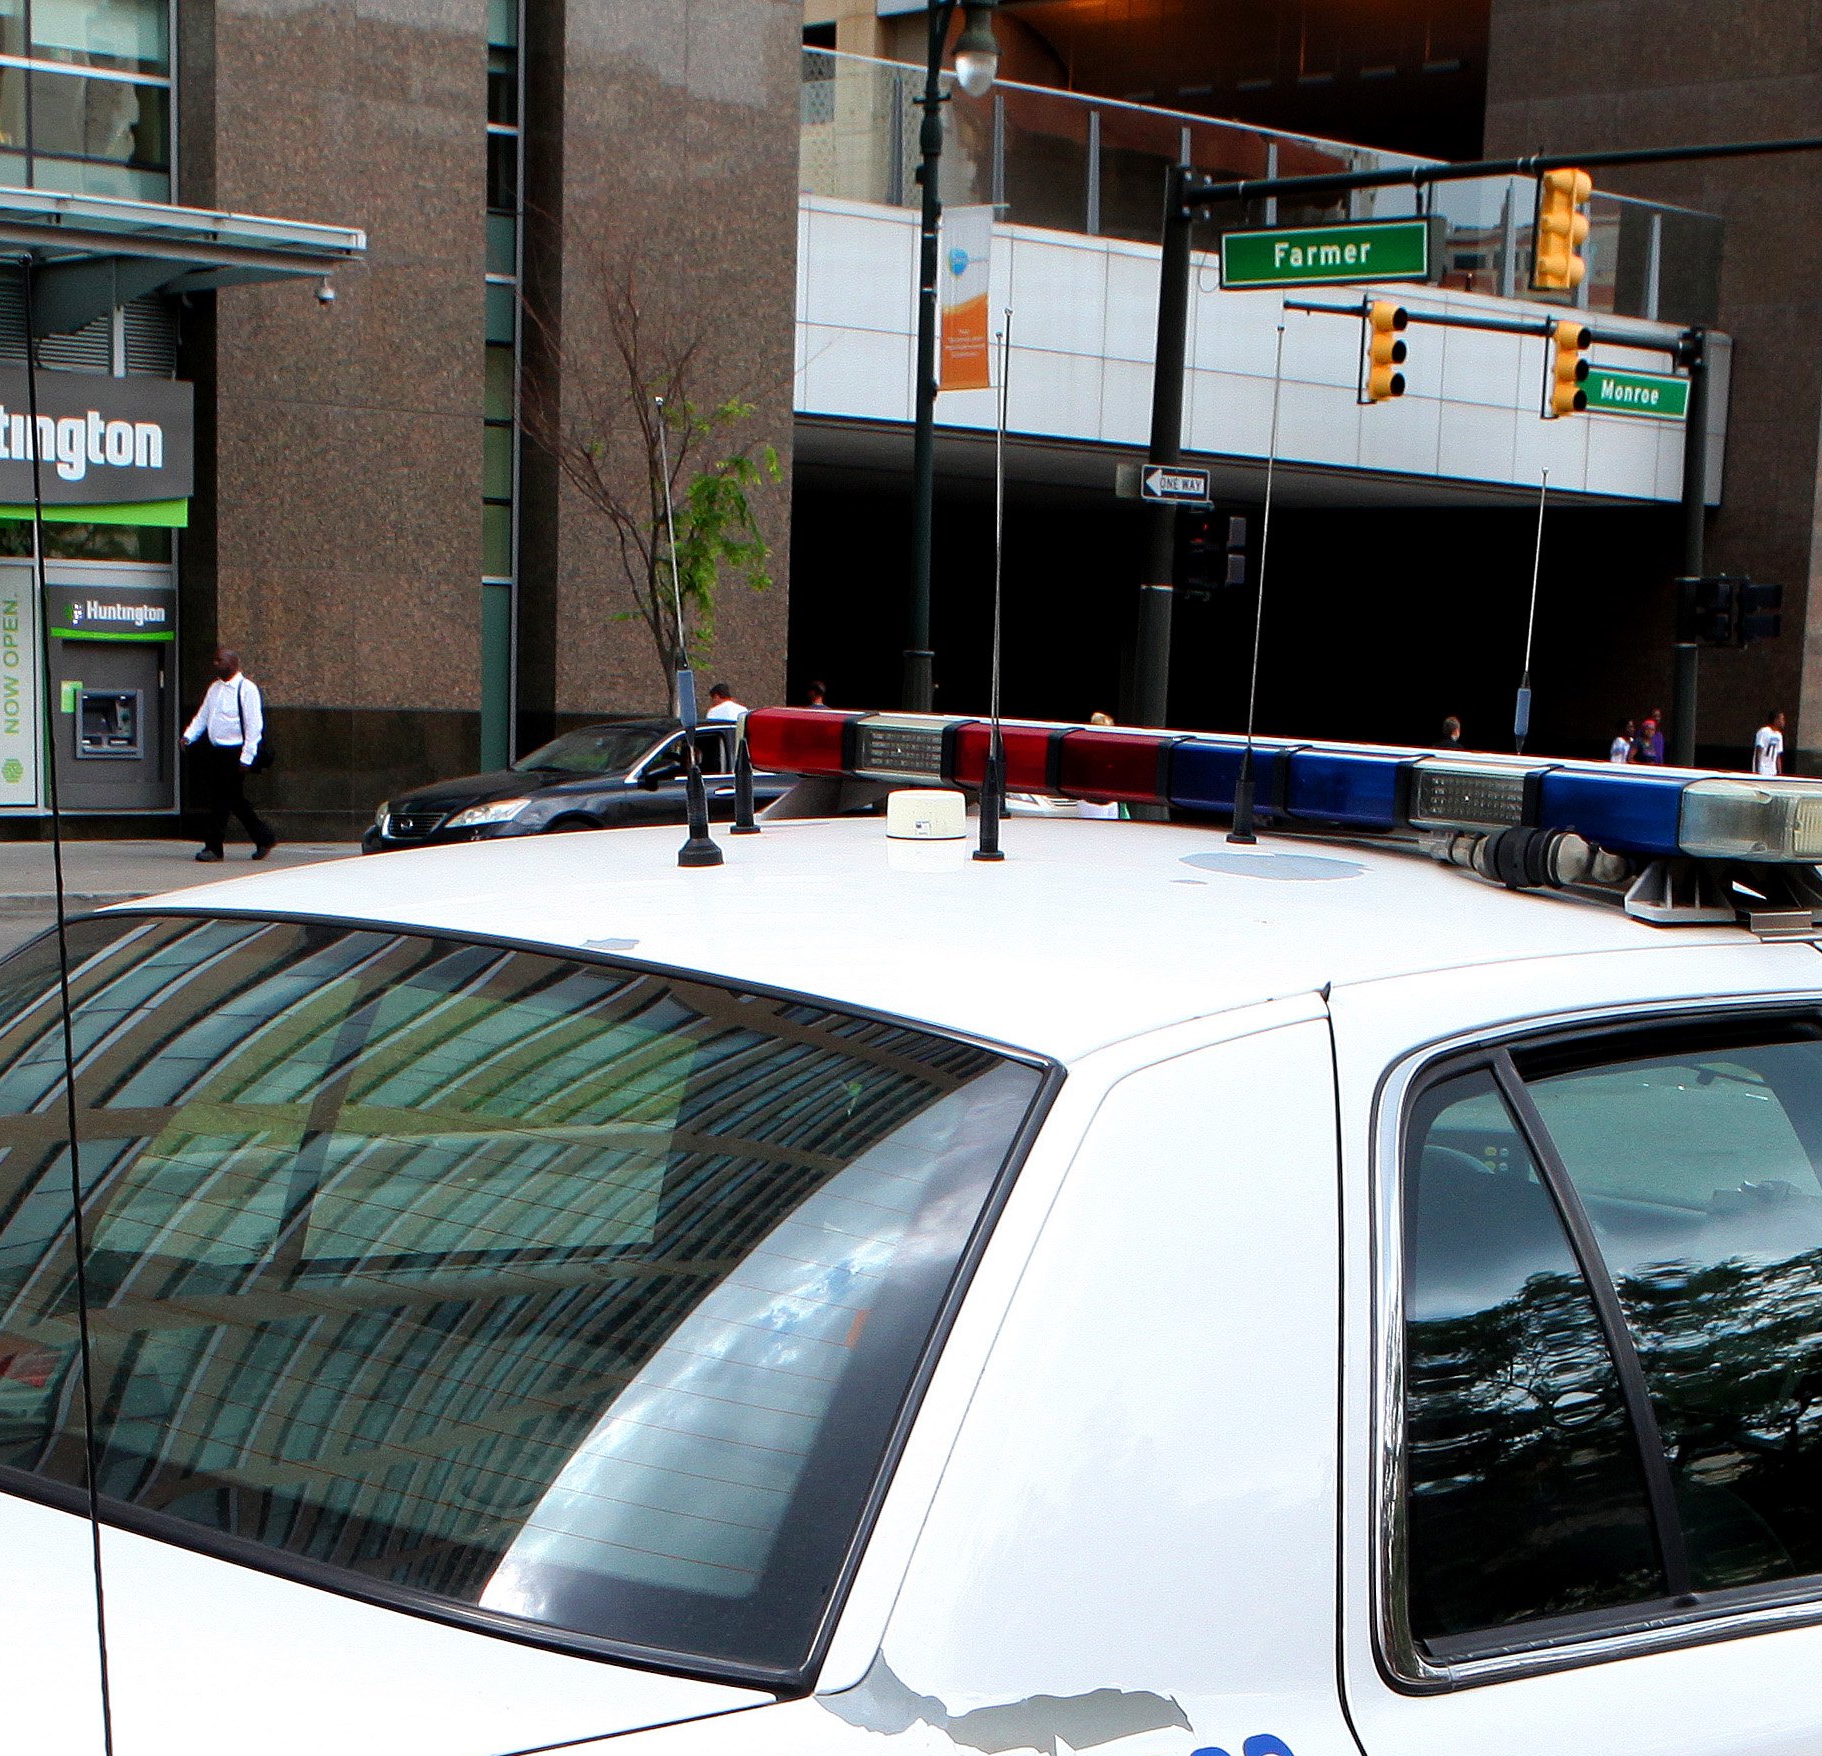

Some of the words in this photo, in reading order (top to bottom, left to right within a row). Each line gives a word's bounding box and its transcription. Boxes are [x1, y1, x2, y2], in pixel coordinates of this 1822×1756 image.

[1274, 240, 1372, 268] Farmer
[1600, 379, 1660, 406] Monroe
[1160, 477, 1179, 492] ONE
[1181, 478, 1201, 494] WAY
[87, 600, 166, 627] Huntington
[2, 593, 20, 669] OPEN.
[3, 674, 21, 736] NOW
